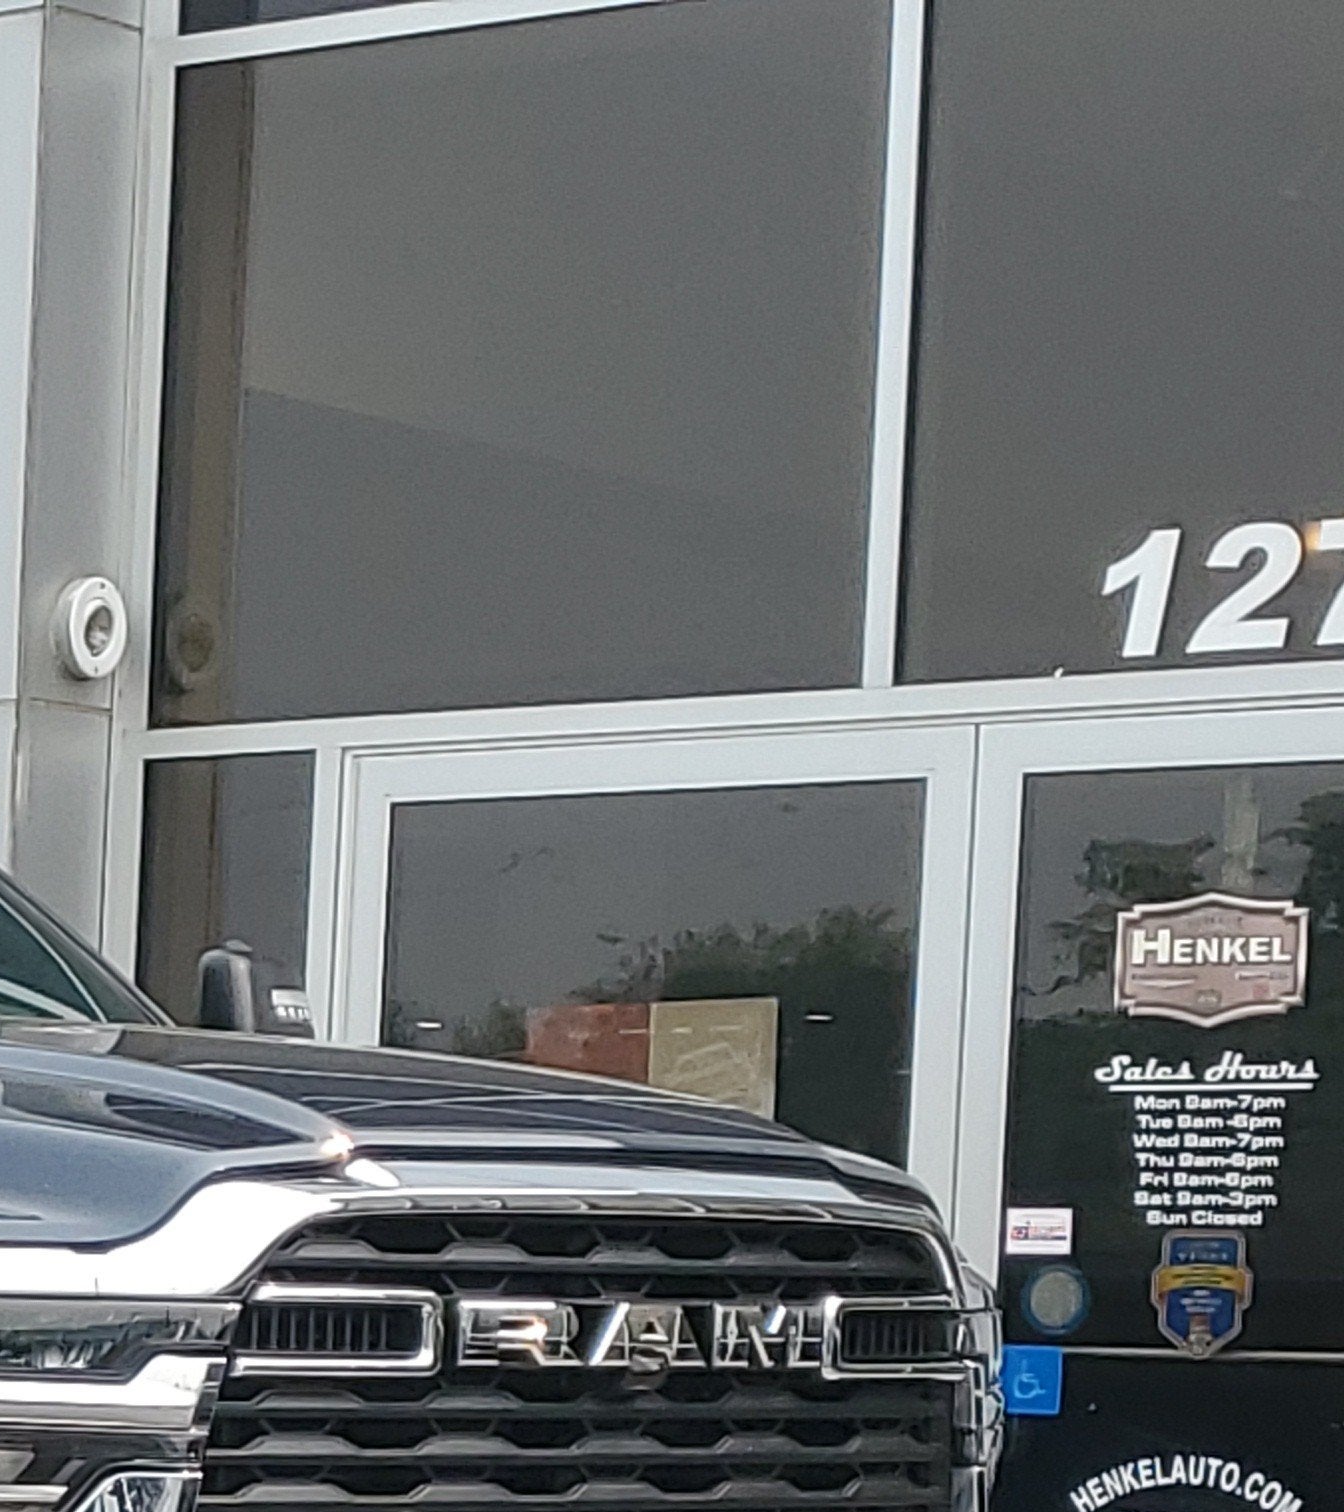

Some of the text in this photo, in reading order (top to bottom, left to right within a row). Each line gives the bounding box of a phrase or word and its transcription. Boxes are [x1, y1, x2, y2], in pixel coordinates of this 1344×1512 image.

[1130, 928, 1293, 965] HENKEL
[1093, 1050, 1321, 1083] Sales Hours
[1134, 1095, 1181, 1110] Mon
[1136, 1114, 1174, 1129] Tue
[1133, 1133, 1180, 1147] Wed
[1135, 1152, 1175, 1167] Thu
[1140, 1172, 1169, 1187] Fri
[1134, 1191, 1172, 1206] Sat
[1146, 1210, 1263, 1226] Sun Closed
[456, 1299, 821, 1369] RAM
